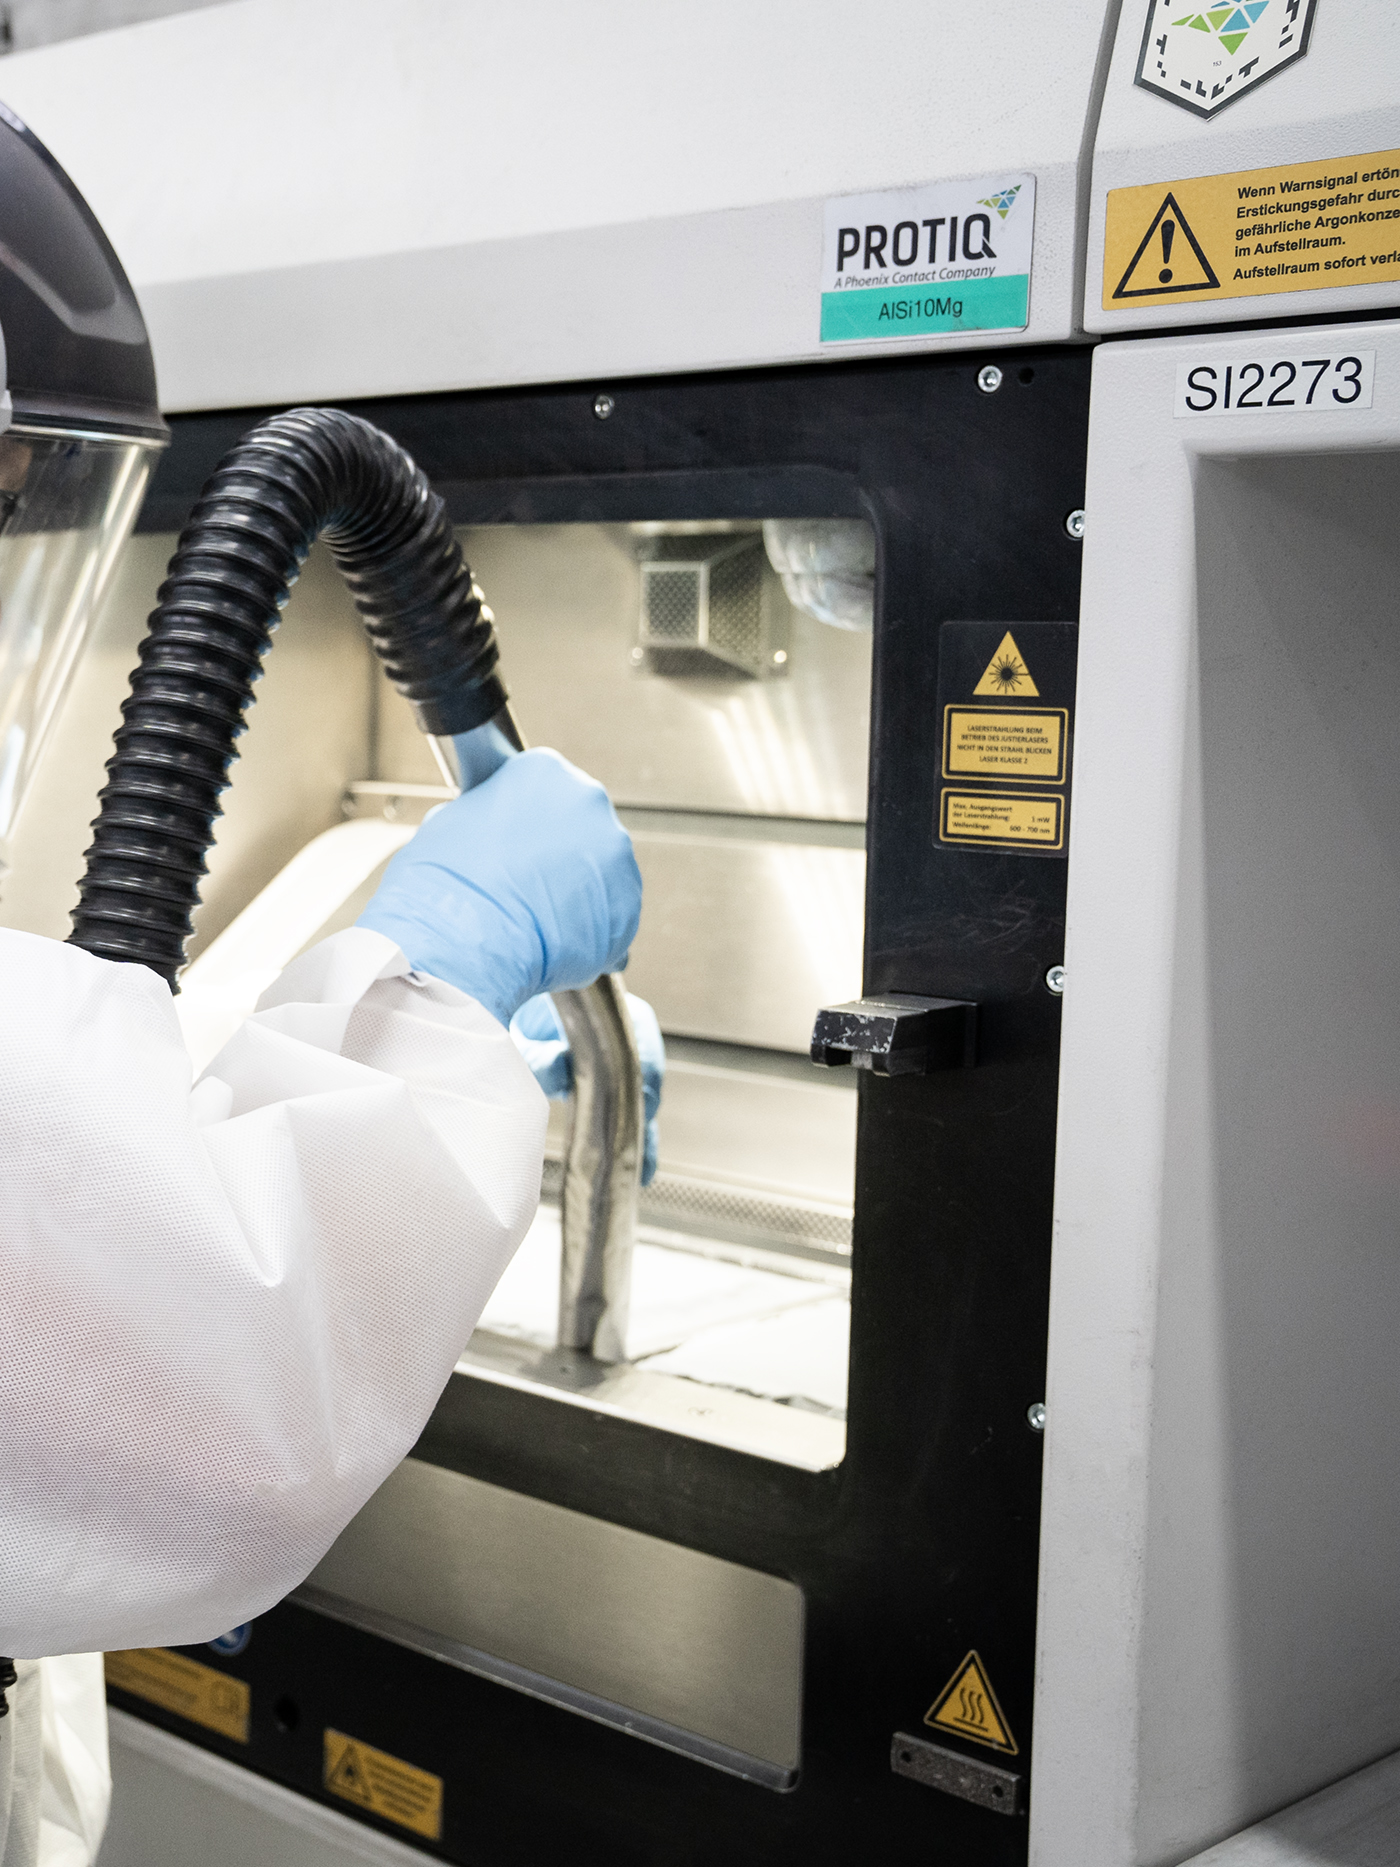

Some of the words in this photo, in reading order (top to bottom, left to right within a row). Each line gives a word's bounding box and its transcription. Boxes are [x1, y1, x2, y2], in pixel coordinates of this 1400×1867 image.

[1237, 186, 1275, 200] Wenn
[1279, 172, 1358, 194] Warnsignal
[1361, 167, 1400, 183] ertön
[1236, 192, 1364, 219] Erstickungsgefahr
[1367, 188, 1400, 202] durc
[1235, 219, 1311, 241] gefährliche
[1313, 208, 1400, 230] Argonkonze
[836, 213, 997, 273] PROTIQ
[1234, 245, 1251, 258] im
[1253, 235, 1346, 256] Aufstellraum.
[833, 277, 843, 290] A
[844, 273, 889, 289] Phoenix
[891, 269, 936, 285] Contact
[938, 264, 997, 281] Company
[1233, 262, 1320, 281] Aufstellraum
[1324, 254, 1367, 271] sofort
[878, 297, 964, 322] AlSi10Mg
[1185, 356, 1364, 412] SI2273
[967, 725, 1024, 734] LASERSTRAHLUNG
